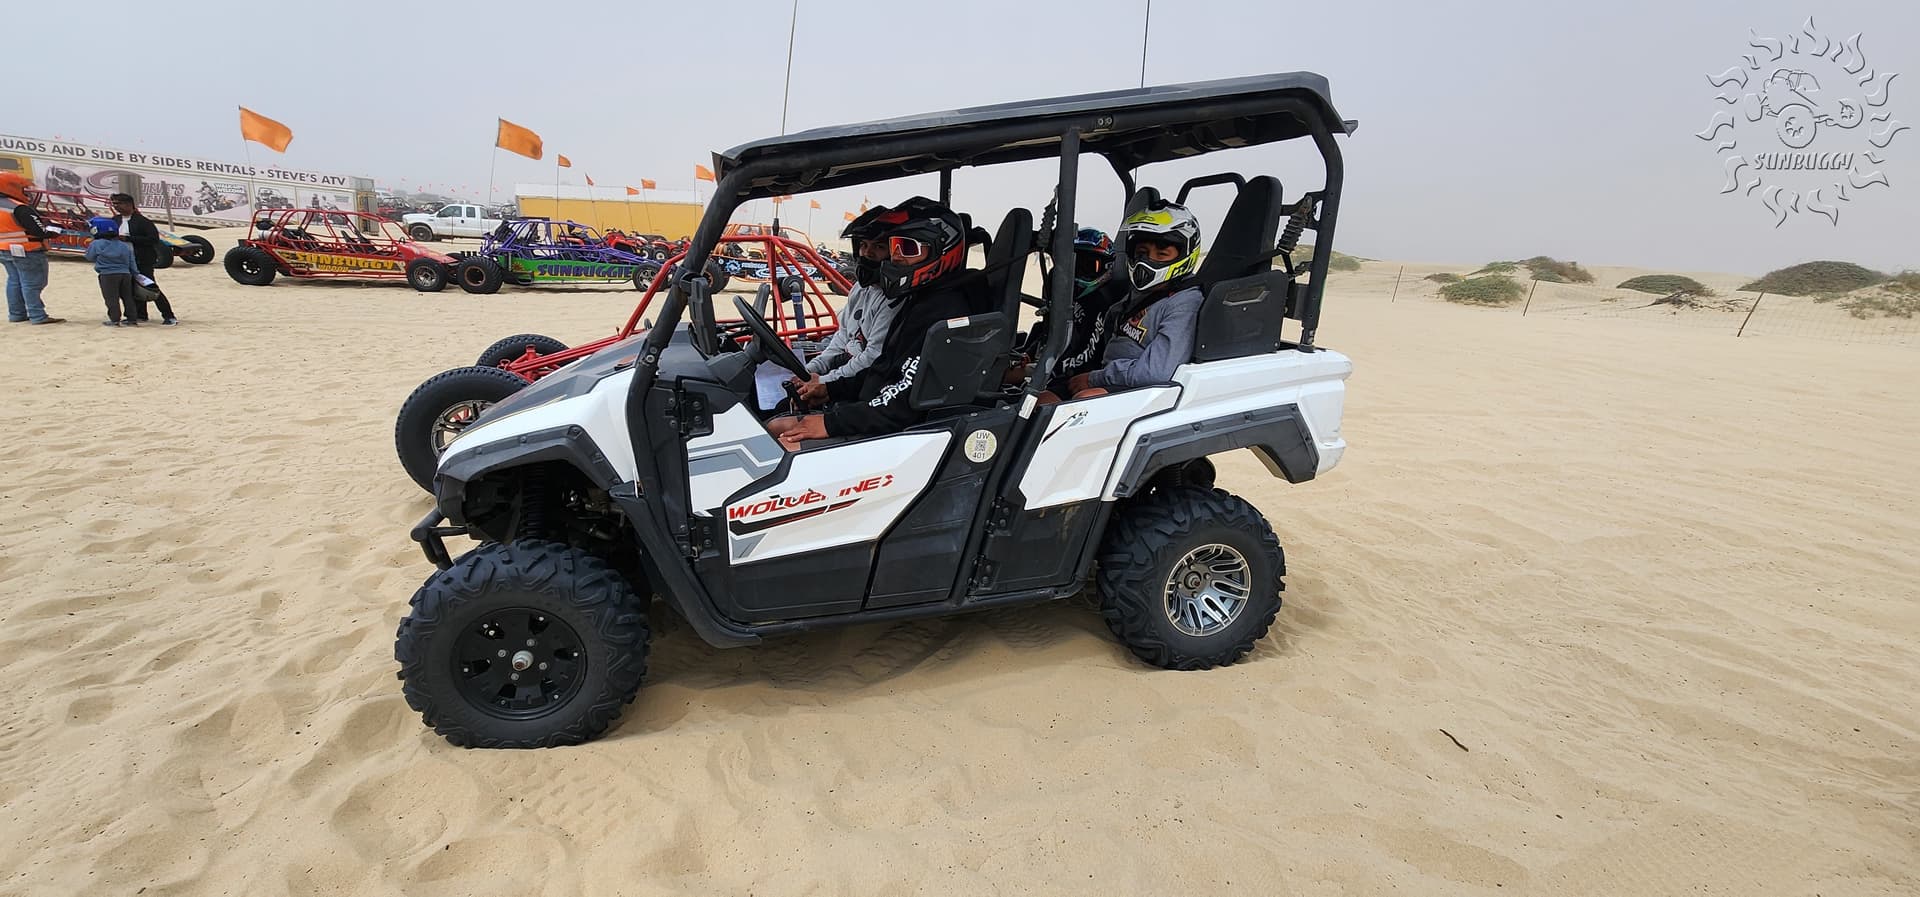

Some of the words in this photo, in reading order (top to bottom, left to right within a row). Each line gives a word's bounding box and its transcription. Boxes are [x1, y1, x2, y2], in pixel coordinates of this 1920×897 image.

[0, 138, 46, 153] UADS
[52, 144, 86, 157] AND
[91, 149, 125, 162] SIDE
[129, 152, 148, 164] BY
[152, 156, 192, 169] SIDES
[196, 160, 256, 176] RENTALS
[267, 169, 317, 183] STEVE'S
[321, 175, 346, 186] ATV
[296, 252, 395, 270] SUNBUGGY
[1122, 322, 1143, 342] DARK
[975, 431, 991, 440] UW
